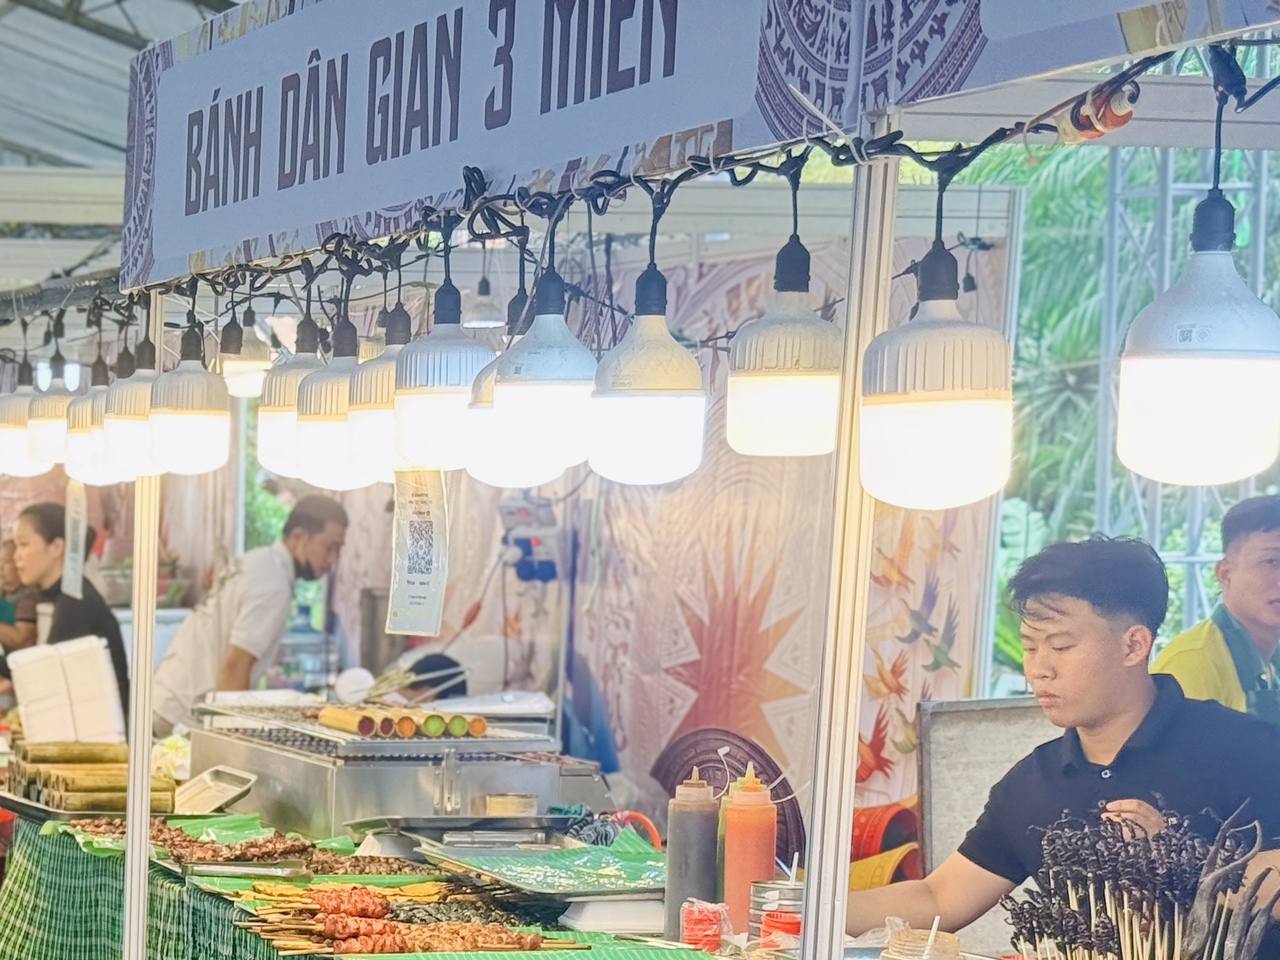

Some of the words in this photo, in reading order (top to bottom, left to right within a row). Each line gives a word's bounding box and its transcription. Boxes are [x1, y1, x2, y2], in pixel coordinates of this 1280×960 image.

[184, 87, 264, 217] BÁNH
[277, 48, 349, 191] DÂN
[365, 6, 464, 166] GIAN
[484, 0, 517, 131] 3
